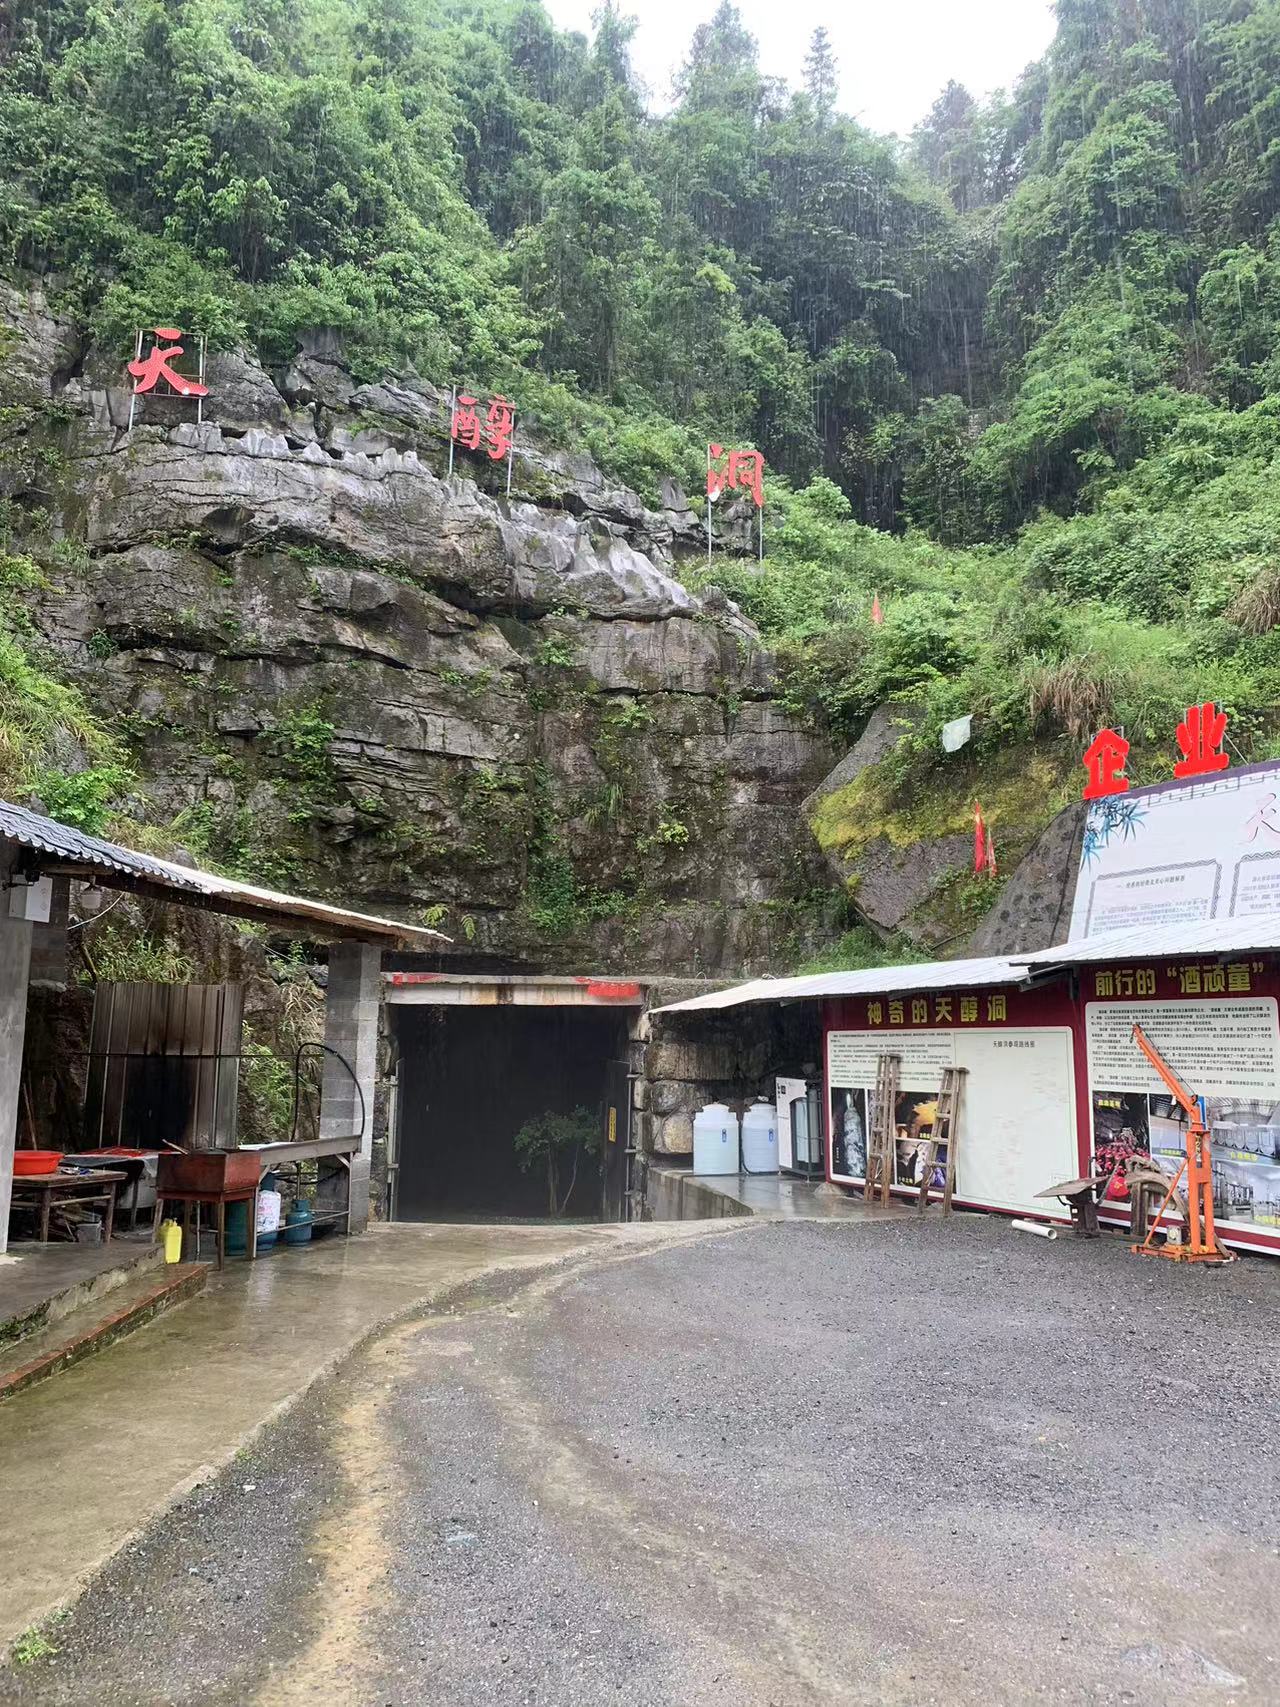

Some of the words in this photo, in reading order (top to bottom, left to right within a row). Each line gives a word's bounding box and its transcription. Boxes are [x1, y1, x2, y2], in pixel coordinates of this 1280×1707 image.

[128, 327, 209, 397] 天
[450, 392, 516, 461] 醇
[705, 442, 765, 508] 洞
[1083, 702, 1230, 800] 企业
[866, 994, 1008, 1025] 神奇的天醇洞
